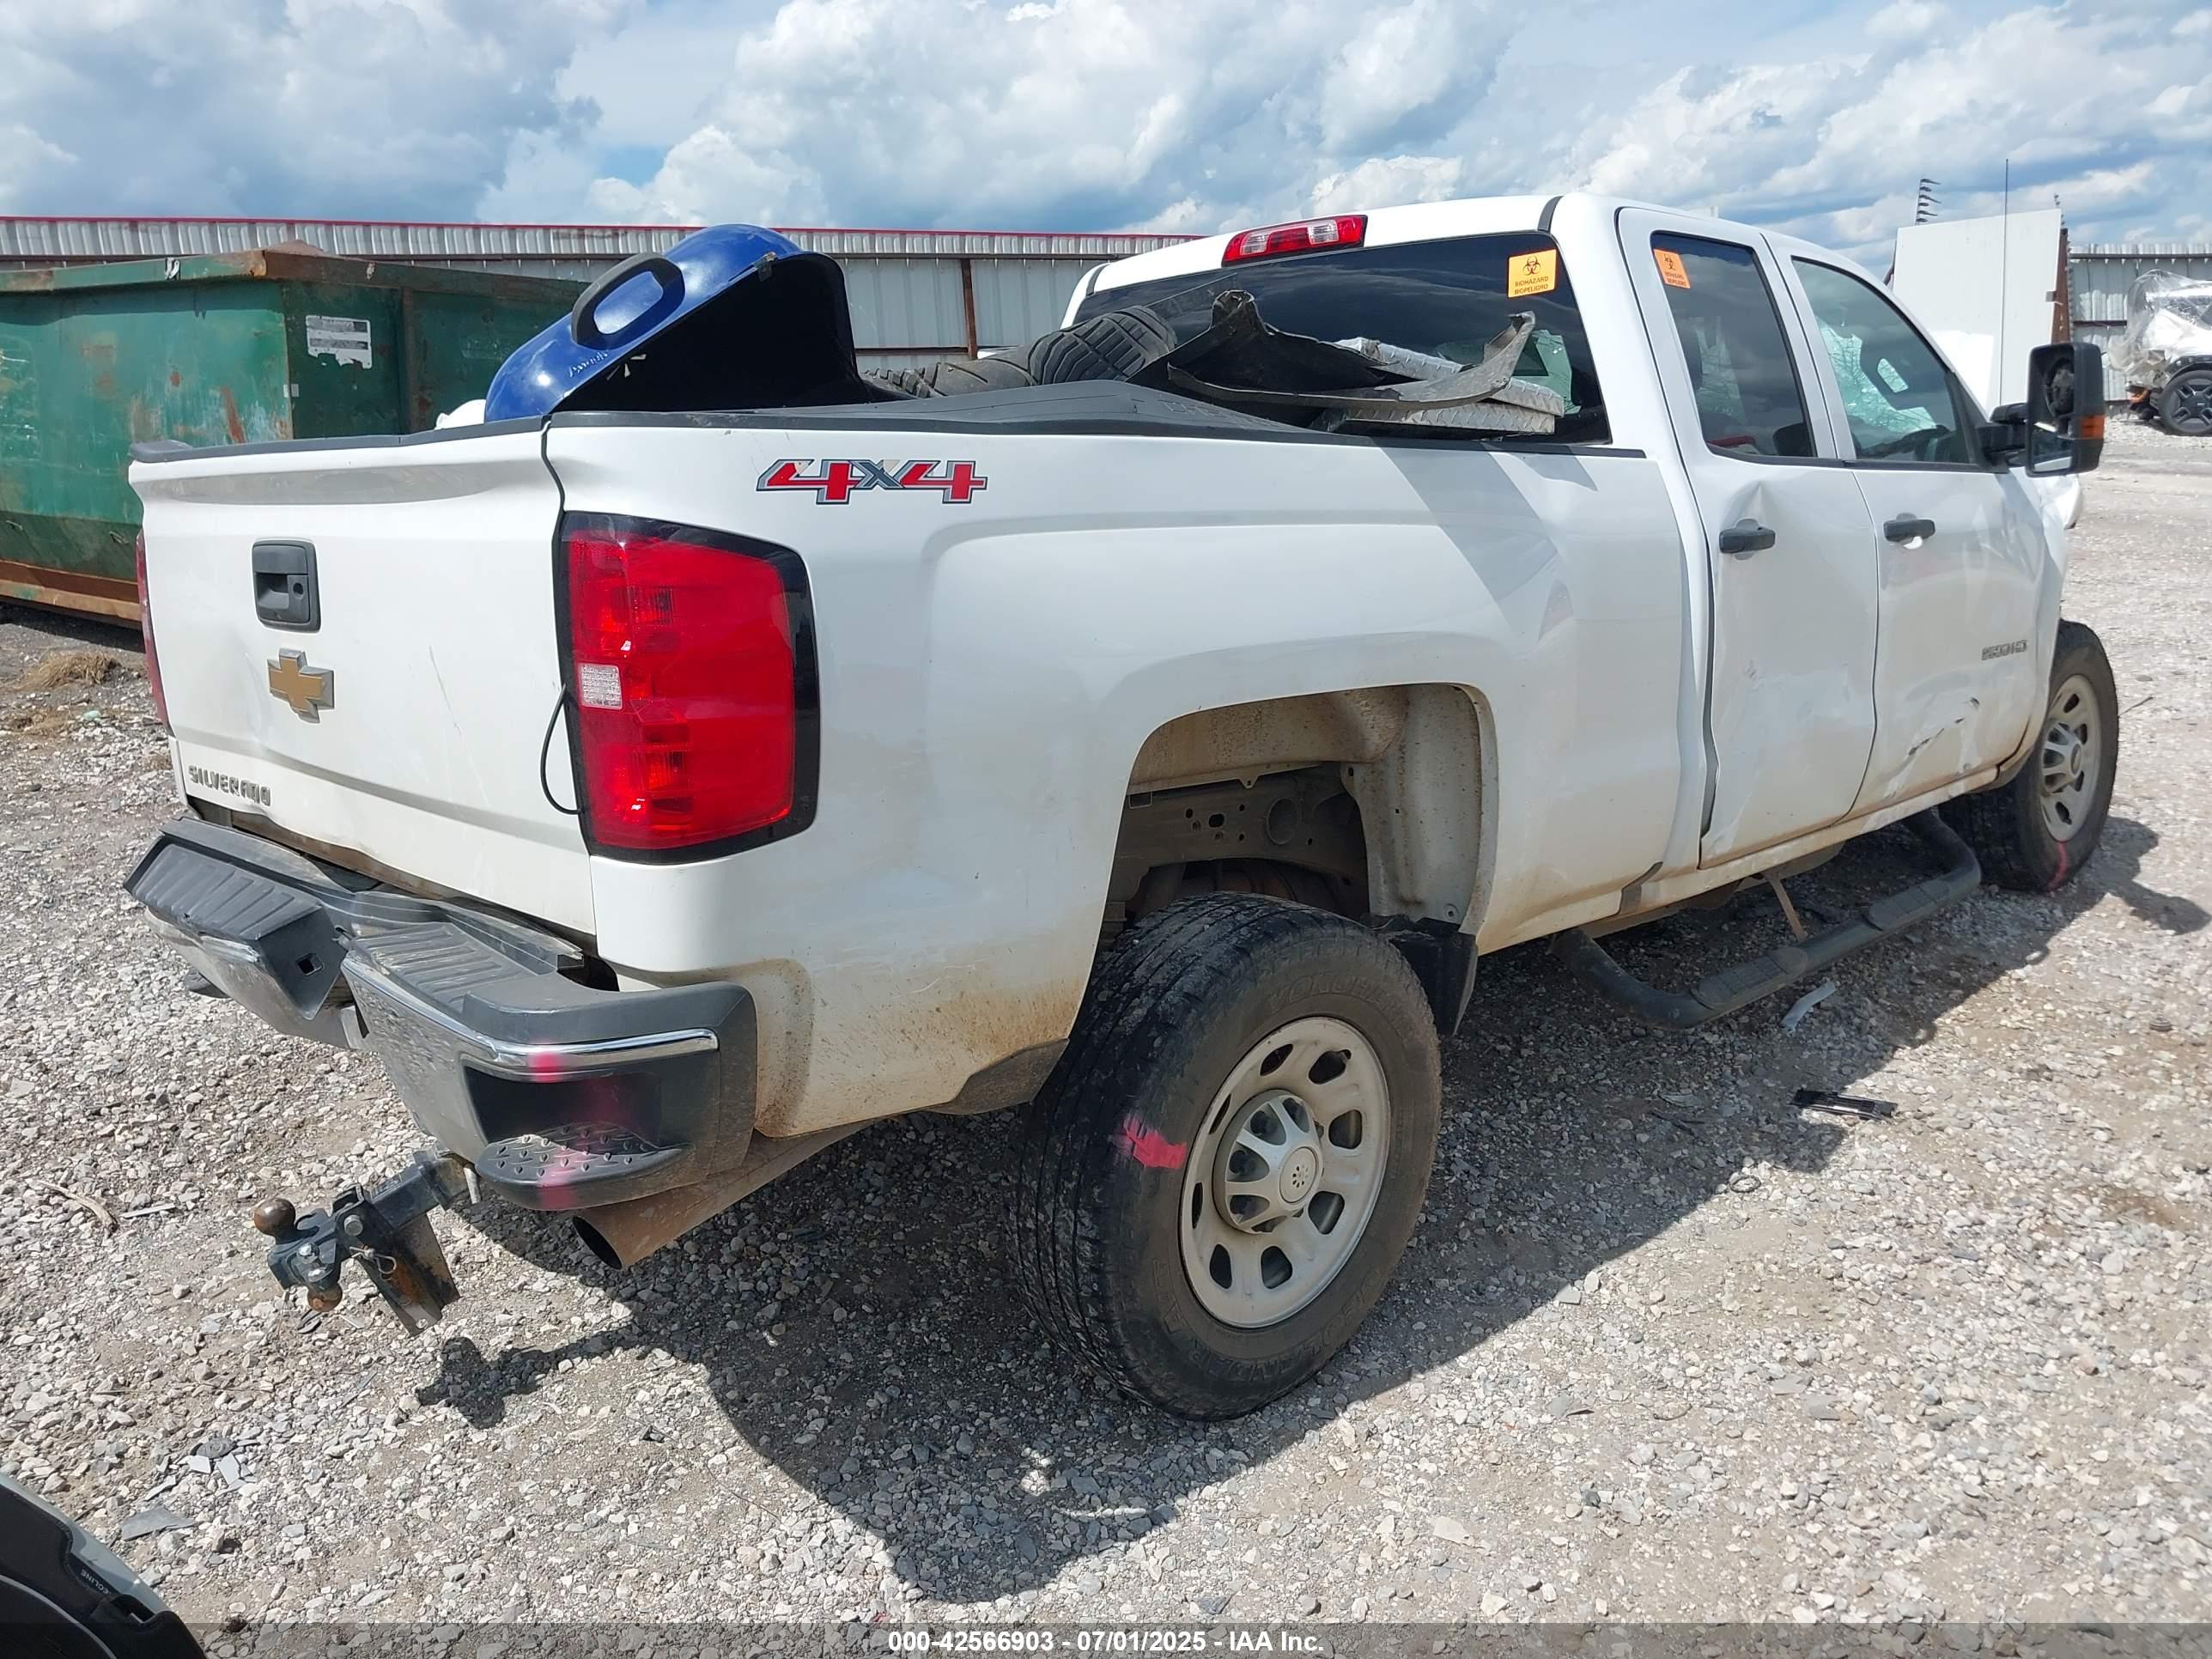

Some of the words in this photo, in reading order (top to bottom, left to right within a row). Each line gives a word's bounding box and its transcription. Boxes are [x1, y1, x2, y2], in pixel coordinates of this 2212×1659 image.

[1515, 276, 1549, 288] BIOHAZARD
[1514, 283, 1549, 295] BIOPELIGRO
[188, 764, 271, 806] SILVERADO
